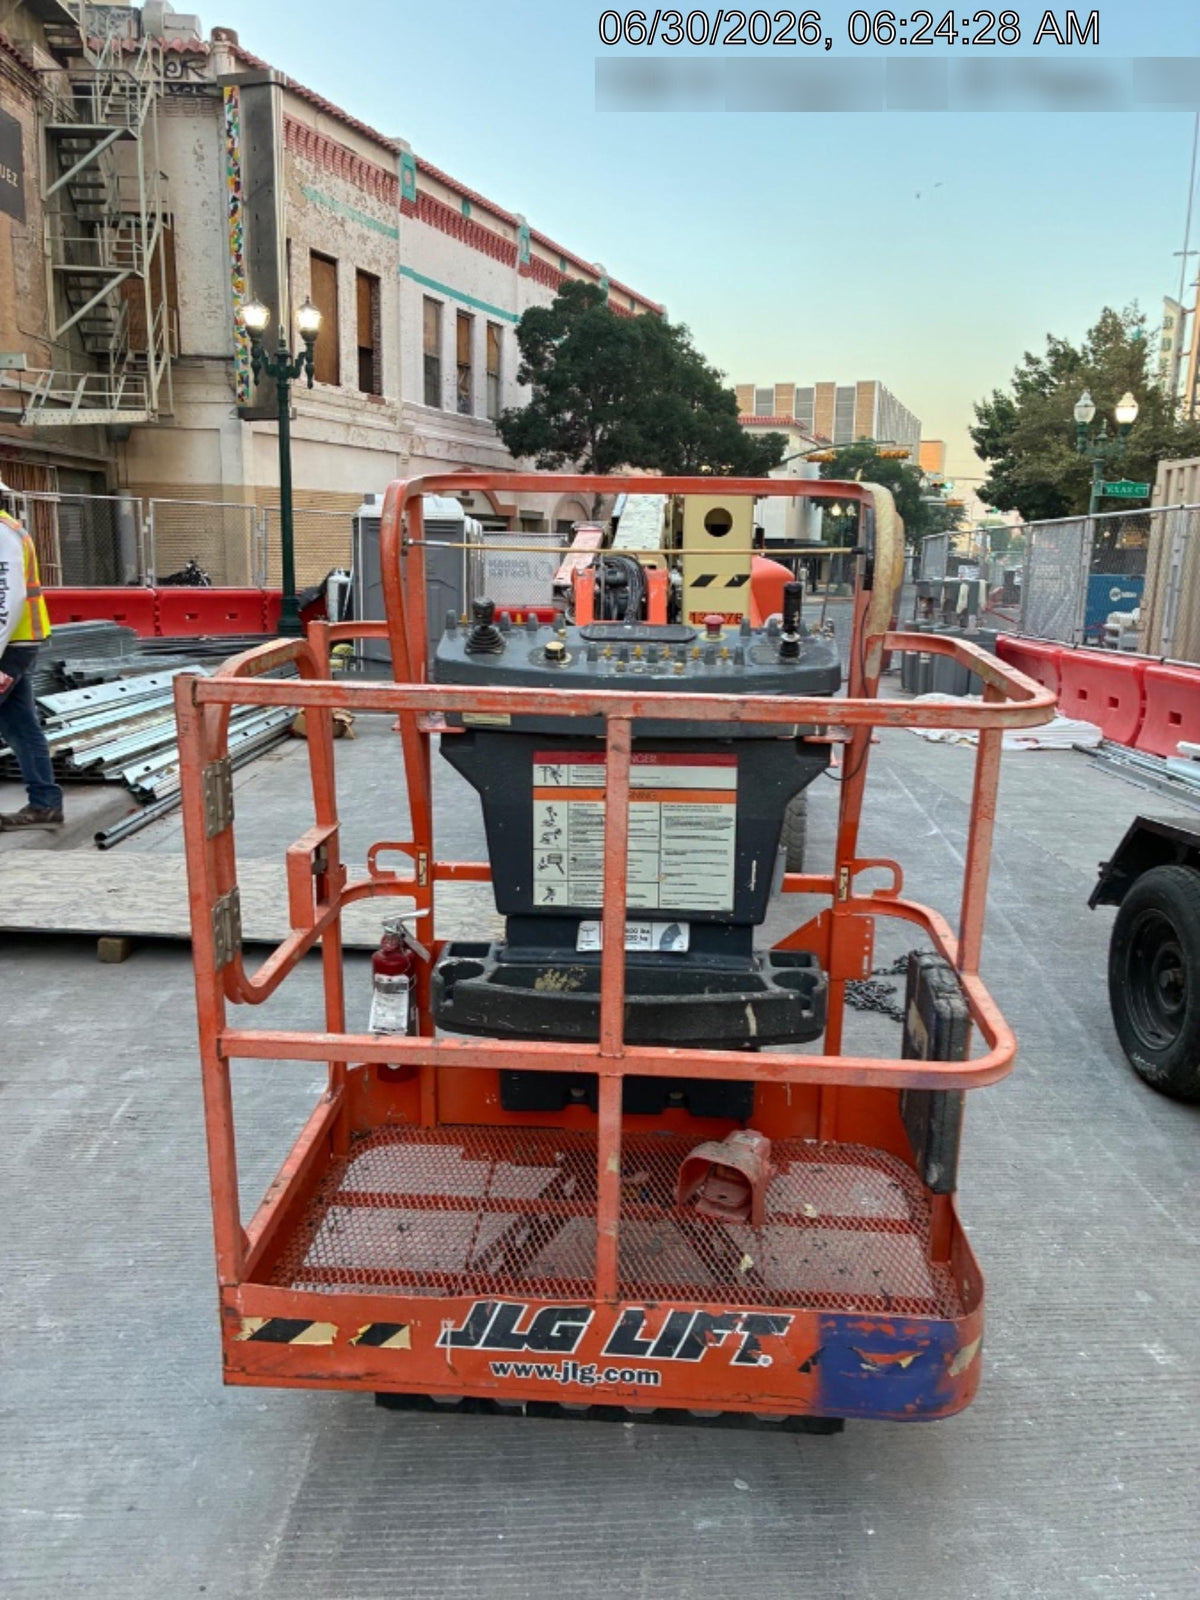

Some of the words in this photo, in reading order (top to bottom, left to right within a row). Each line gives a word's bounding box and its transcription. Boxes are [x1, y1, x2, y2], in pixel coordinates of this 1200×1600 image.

[435, 1300, 595, 1354] JLG
[600, 1306, 796, 1367] LIFT
[489, 1359, 662, 1387] www.jlg.com
